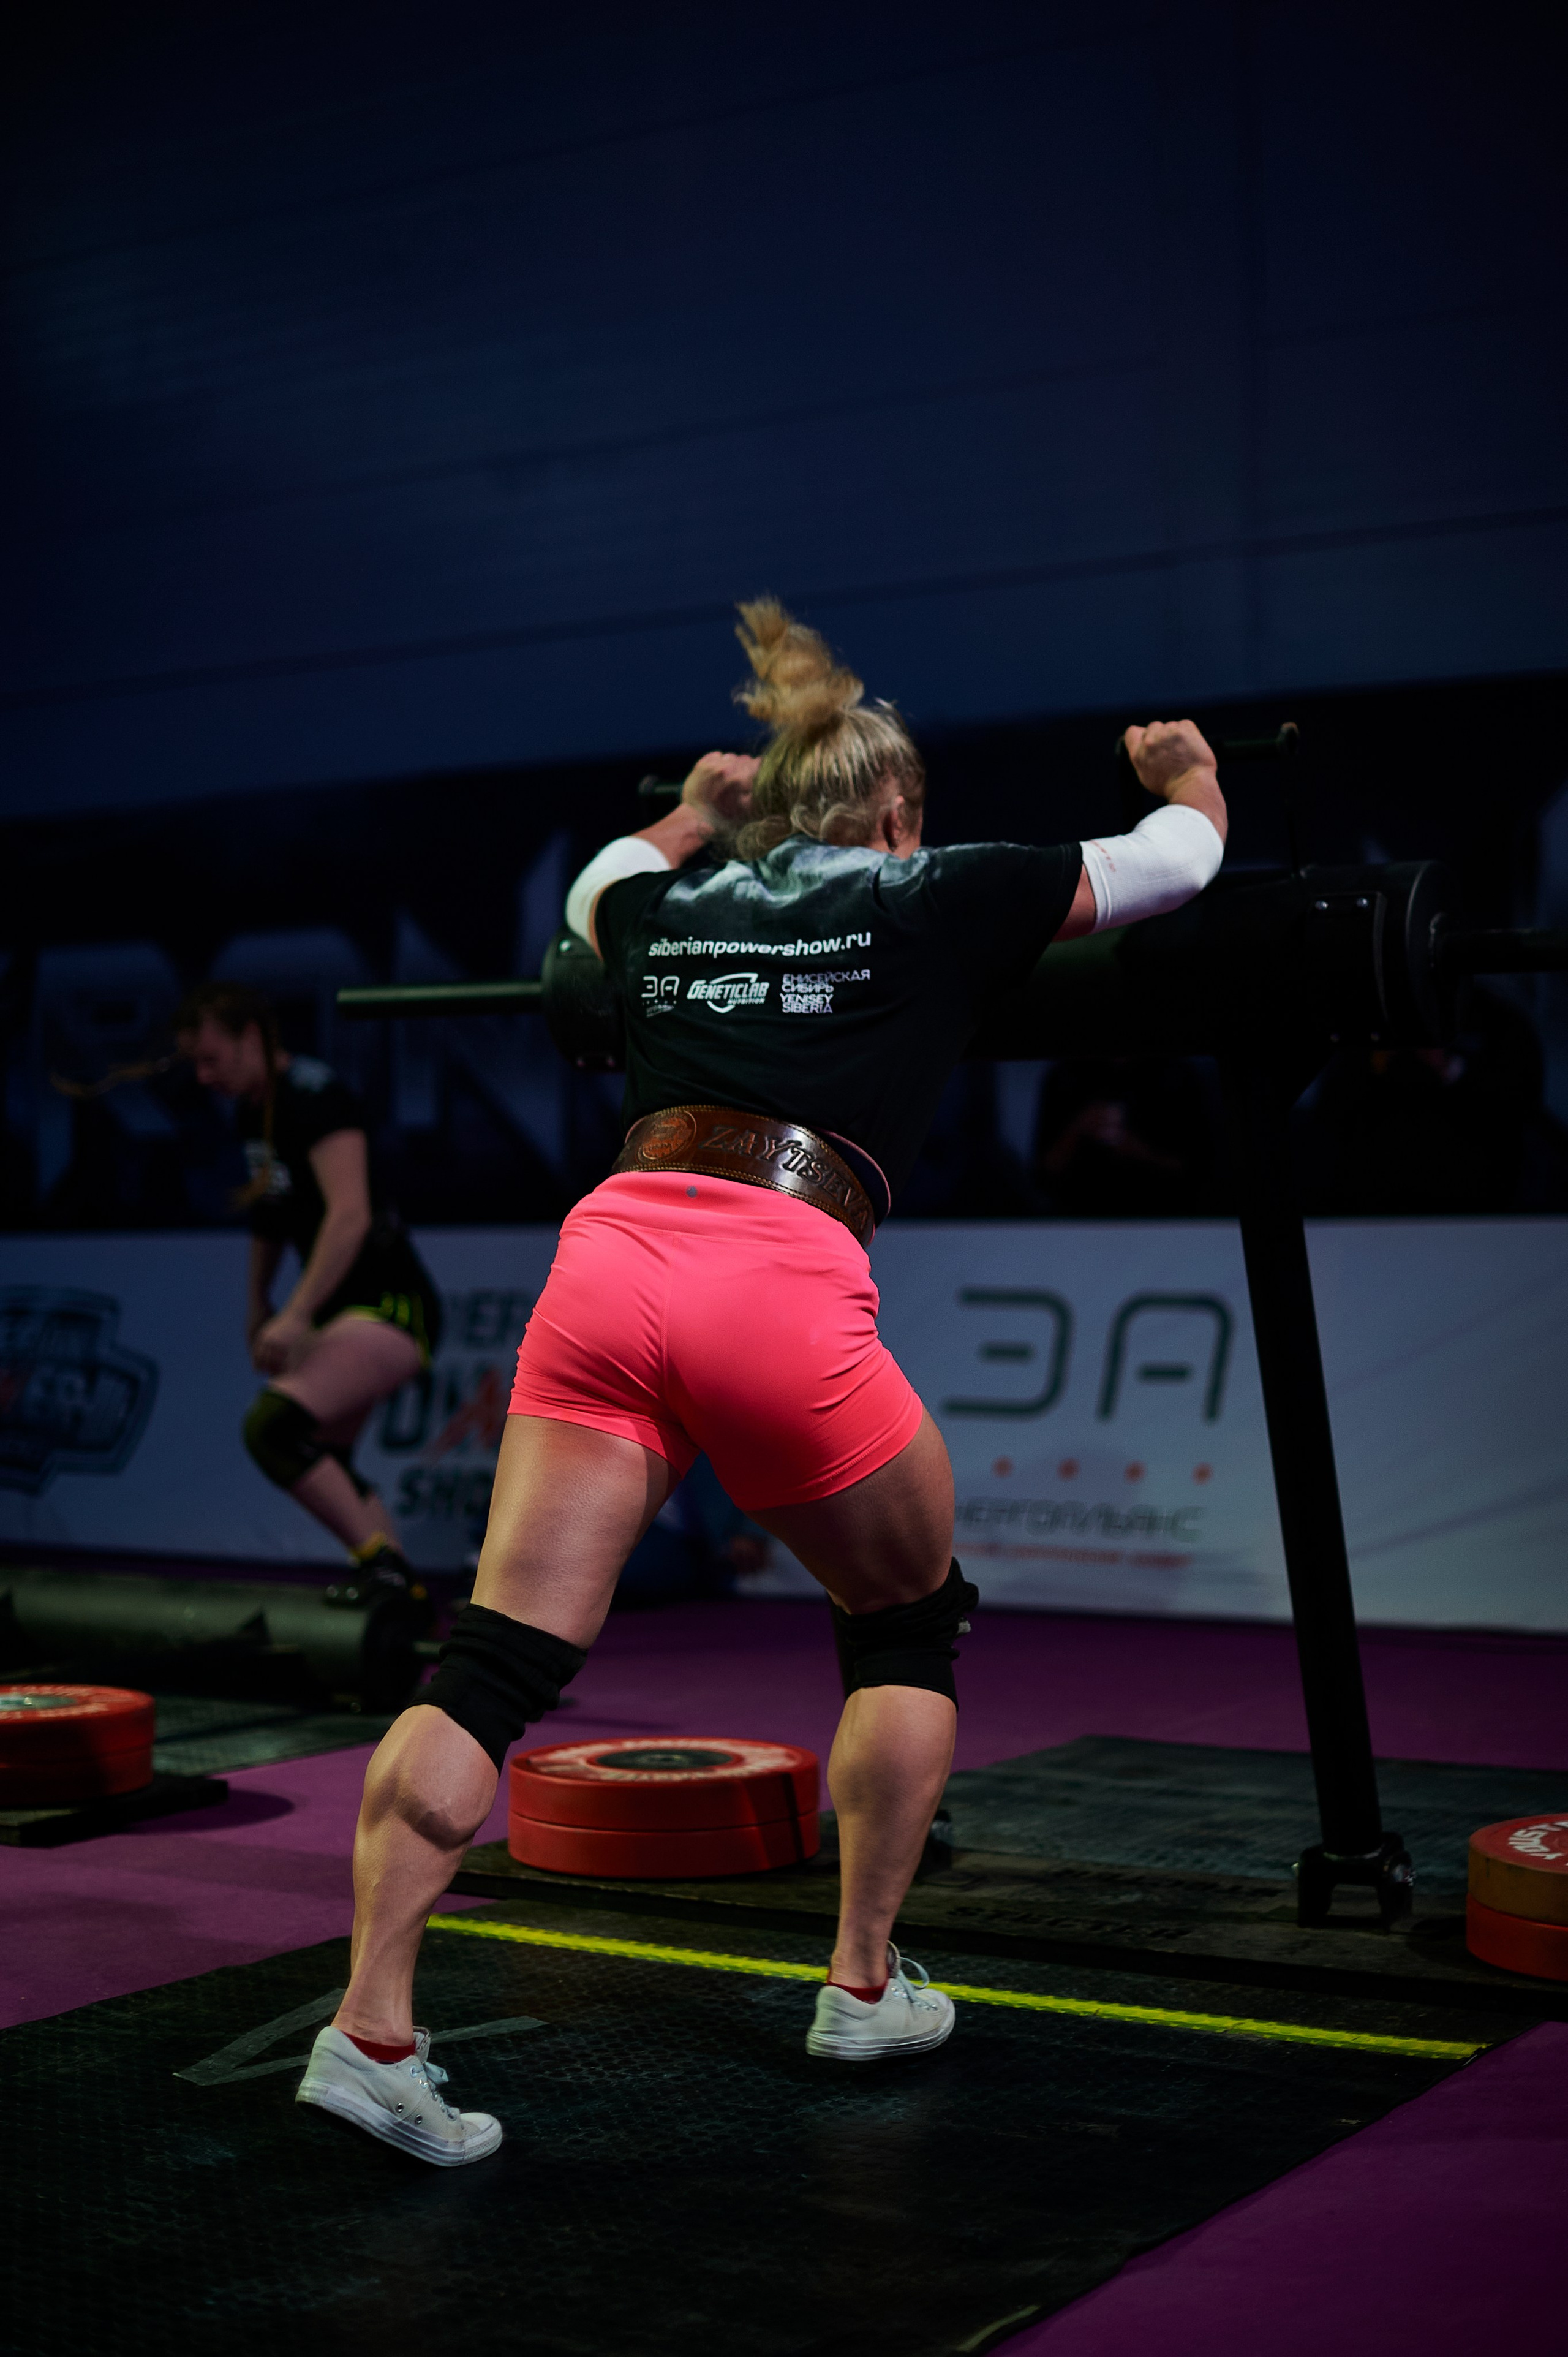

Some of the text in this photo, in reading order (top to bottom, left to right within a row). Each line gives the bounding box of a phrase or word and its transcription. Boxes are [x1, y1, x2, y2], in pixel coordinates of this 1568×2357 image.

[648, 931, 872, 958] siberianpowershow.ru
[783, 969, 871, 984] ЕНИСЕЙСКАЯ
[687, 979, 770, 1000] GENETICLAB
[782, 983, 834, 993] СИБИРЬ
[780, 993, 834, 1004] YENISEY
[782, 1002, 833, 1014] SIBERIA
[699, 1125, 870, 1233] ZAYTSEVA
[1507, 1821, 1568, 1861] YOUST
